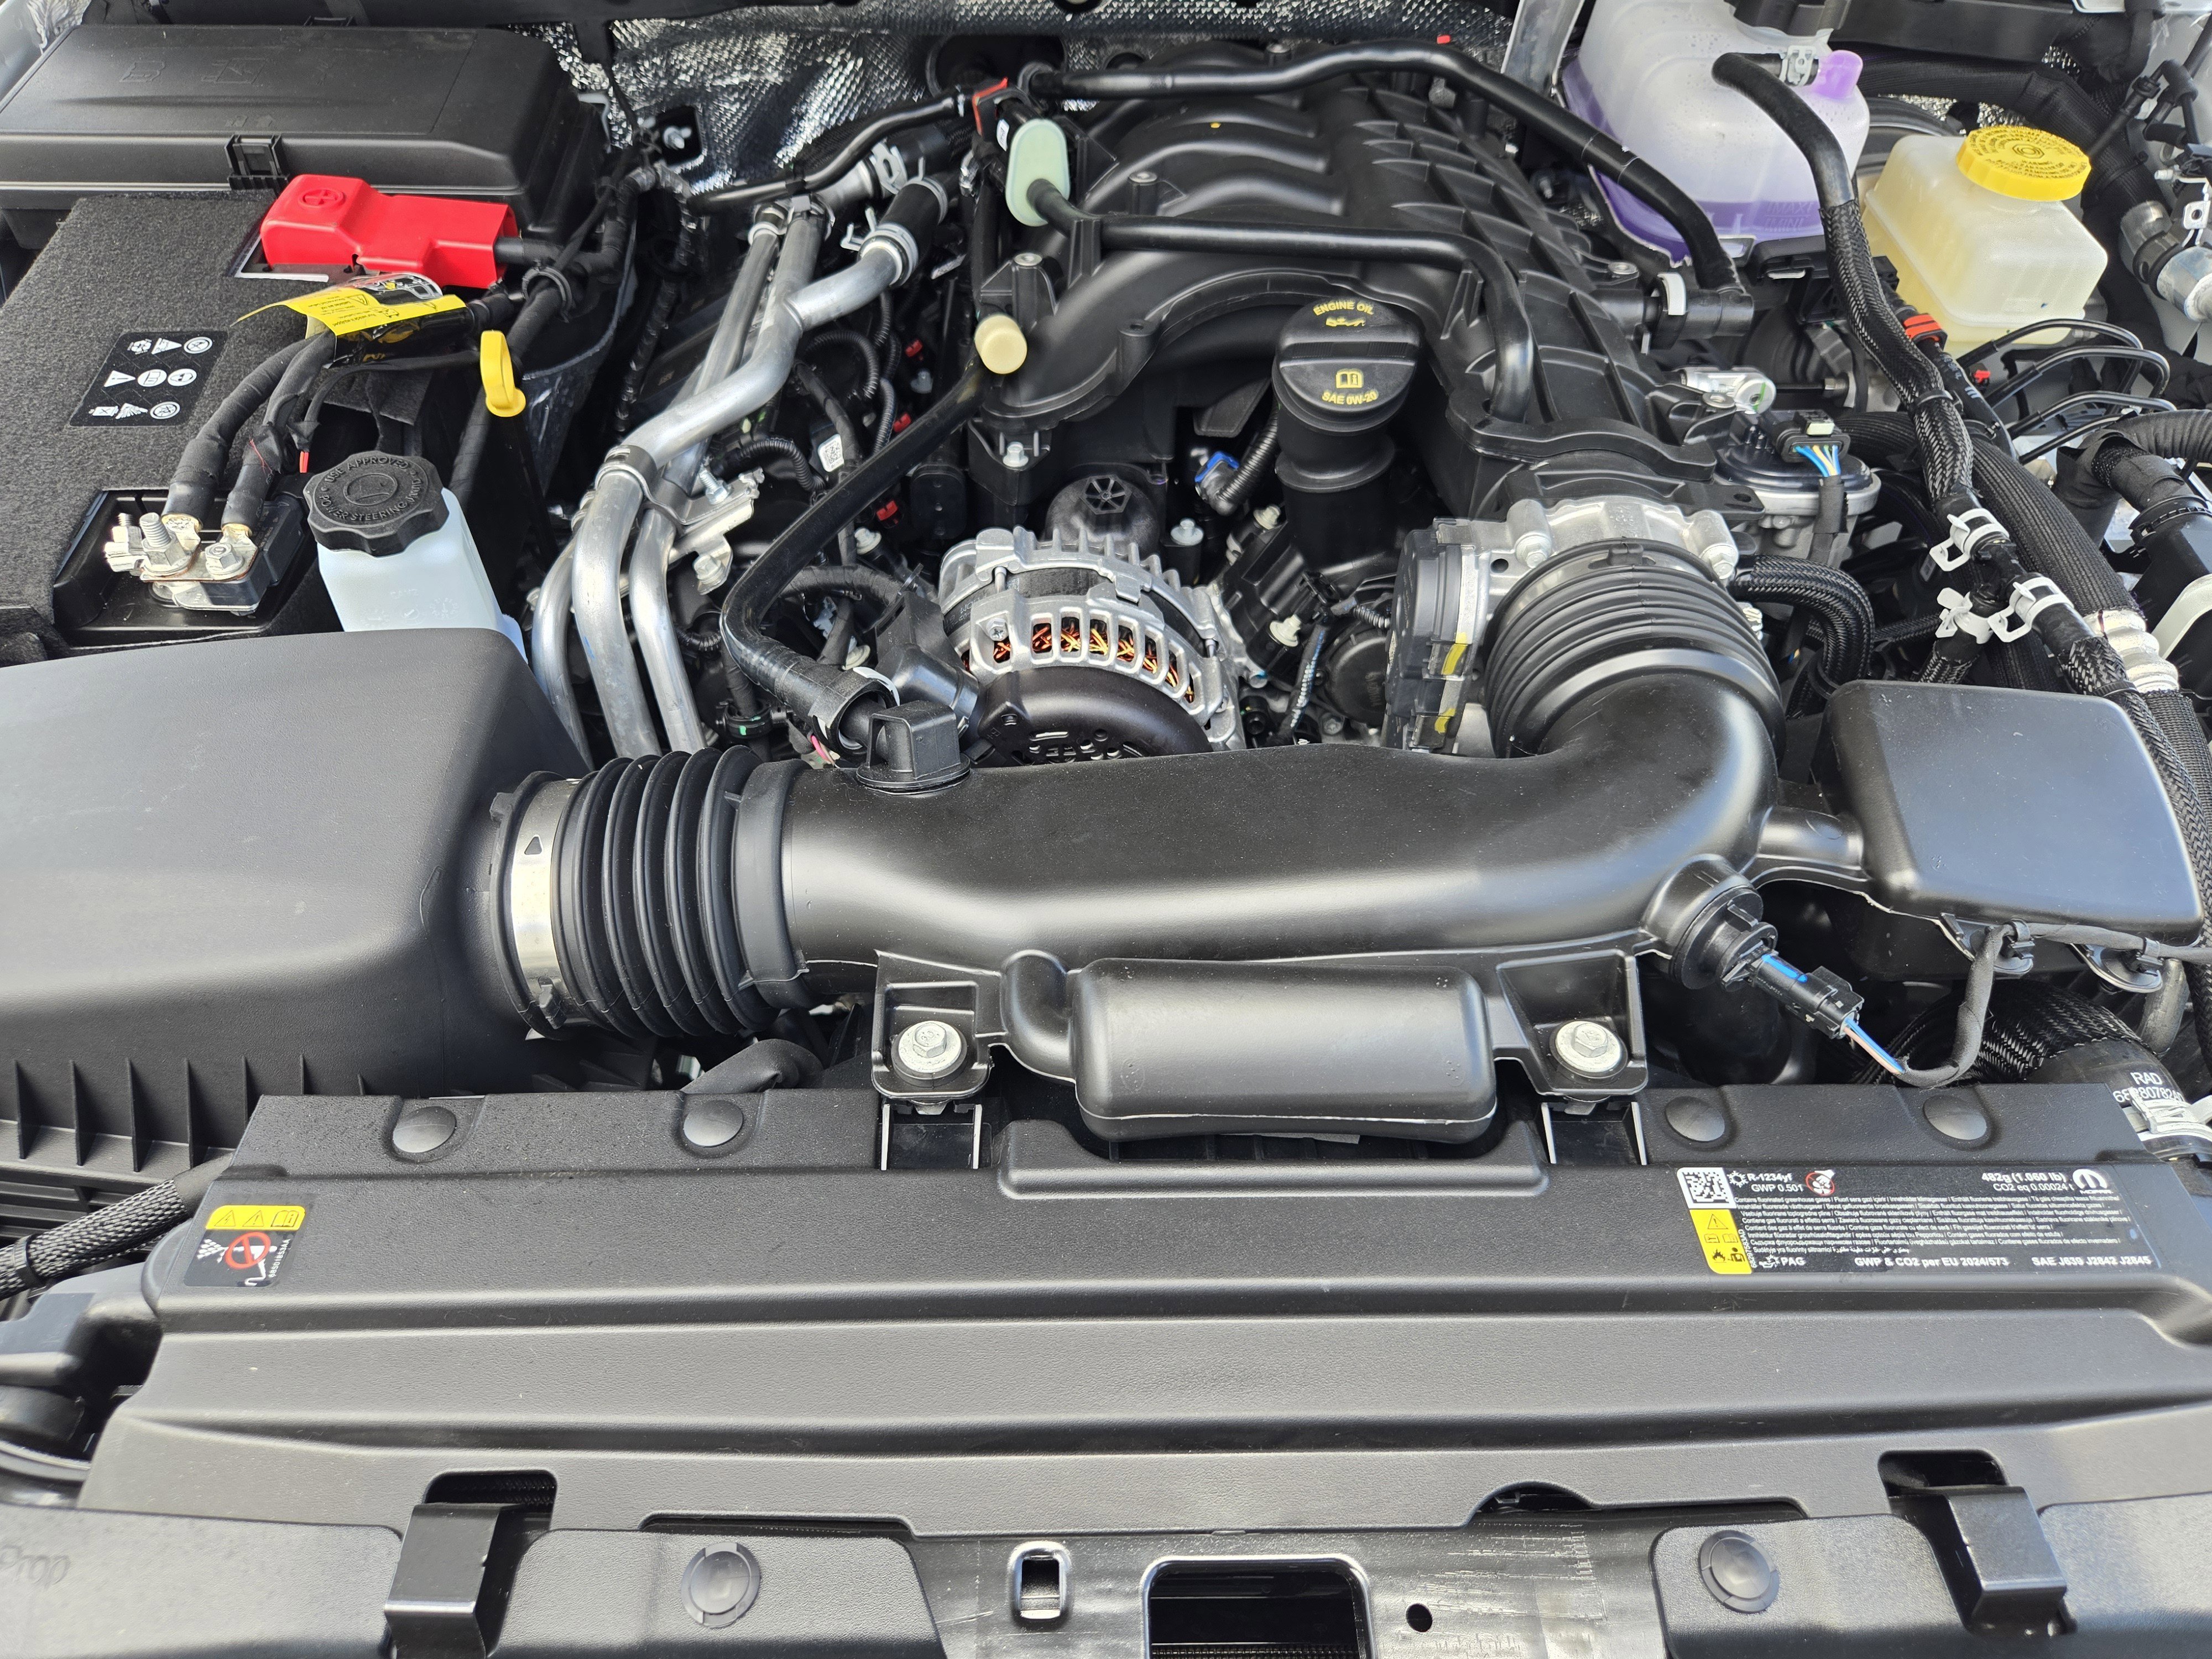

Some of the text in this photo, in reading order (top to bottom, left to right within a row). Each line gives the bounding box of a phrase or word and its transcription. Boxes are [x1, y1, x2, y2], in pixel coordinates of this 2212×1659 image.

[1313, 301, 1374, 316] ENGINE OIL
[1322, 389, 1379, 405] SAE 0W-20
[324, 456, 410, 483] USE APPROVED
[319, 494, 349, 520] POWER
[350, 500, 409, 521] STEERING
[2130, 1072, 2163, 1086] RAD
[1747, 1173, 1793, 1183] R-1234yf
[1981, 1172, 2067, 1183] 482g (1.060 lb)
[1751, 1184, 1804, 1192] GWP 0.501
[2030, 1183, 2068, 1191] 0.00024
[1781, 1257, 1806, 1266] PAG
[1854, 1257, 2010, 1268] GWP & CO2 per EU 2024/573
[2031, 1256, 2152, 1266] SAE J639 J2842 J2845
